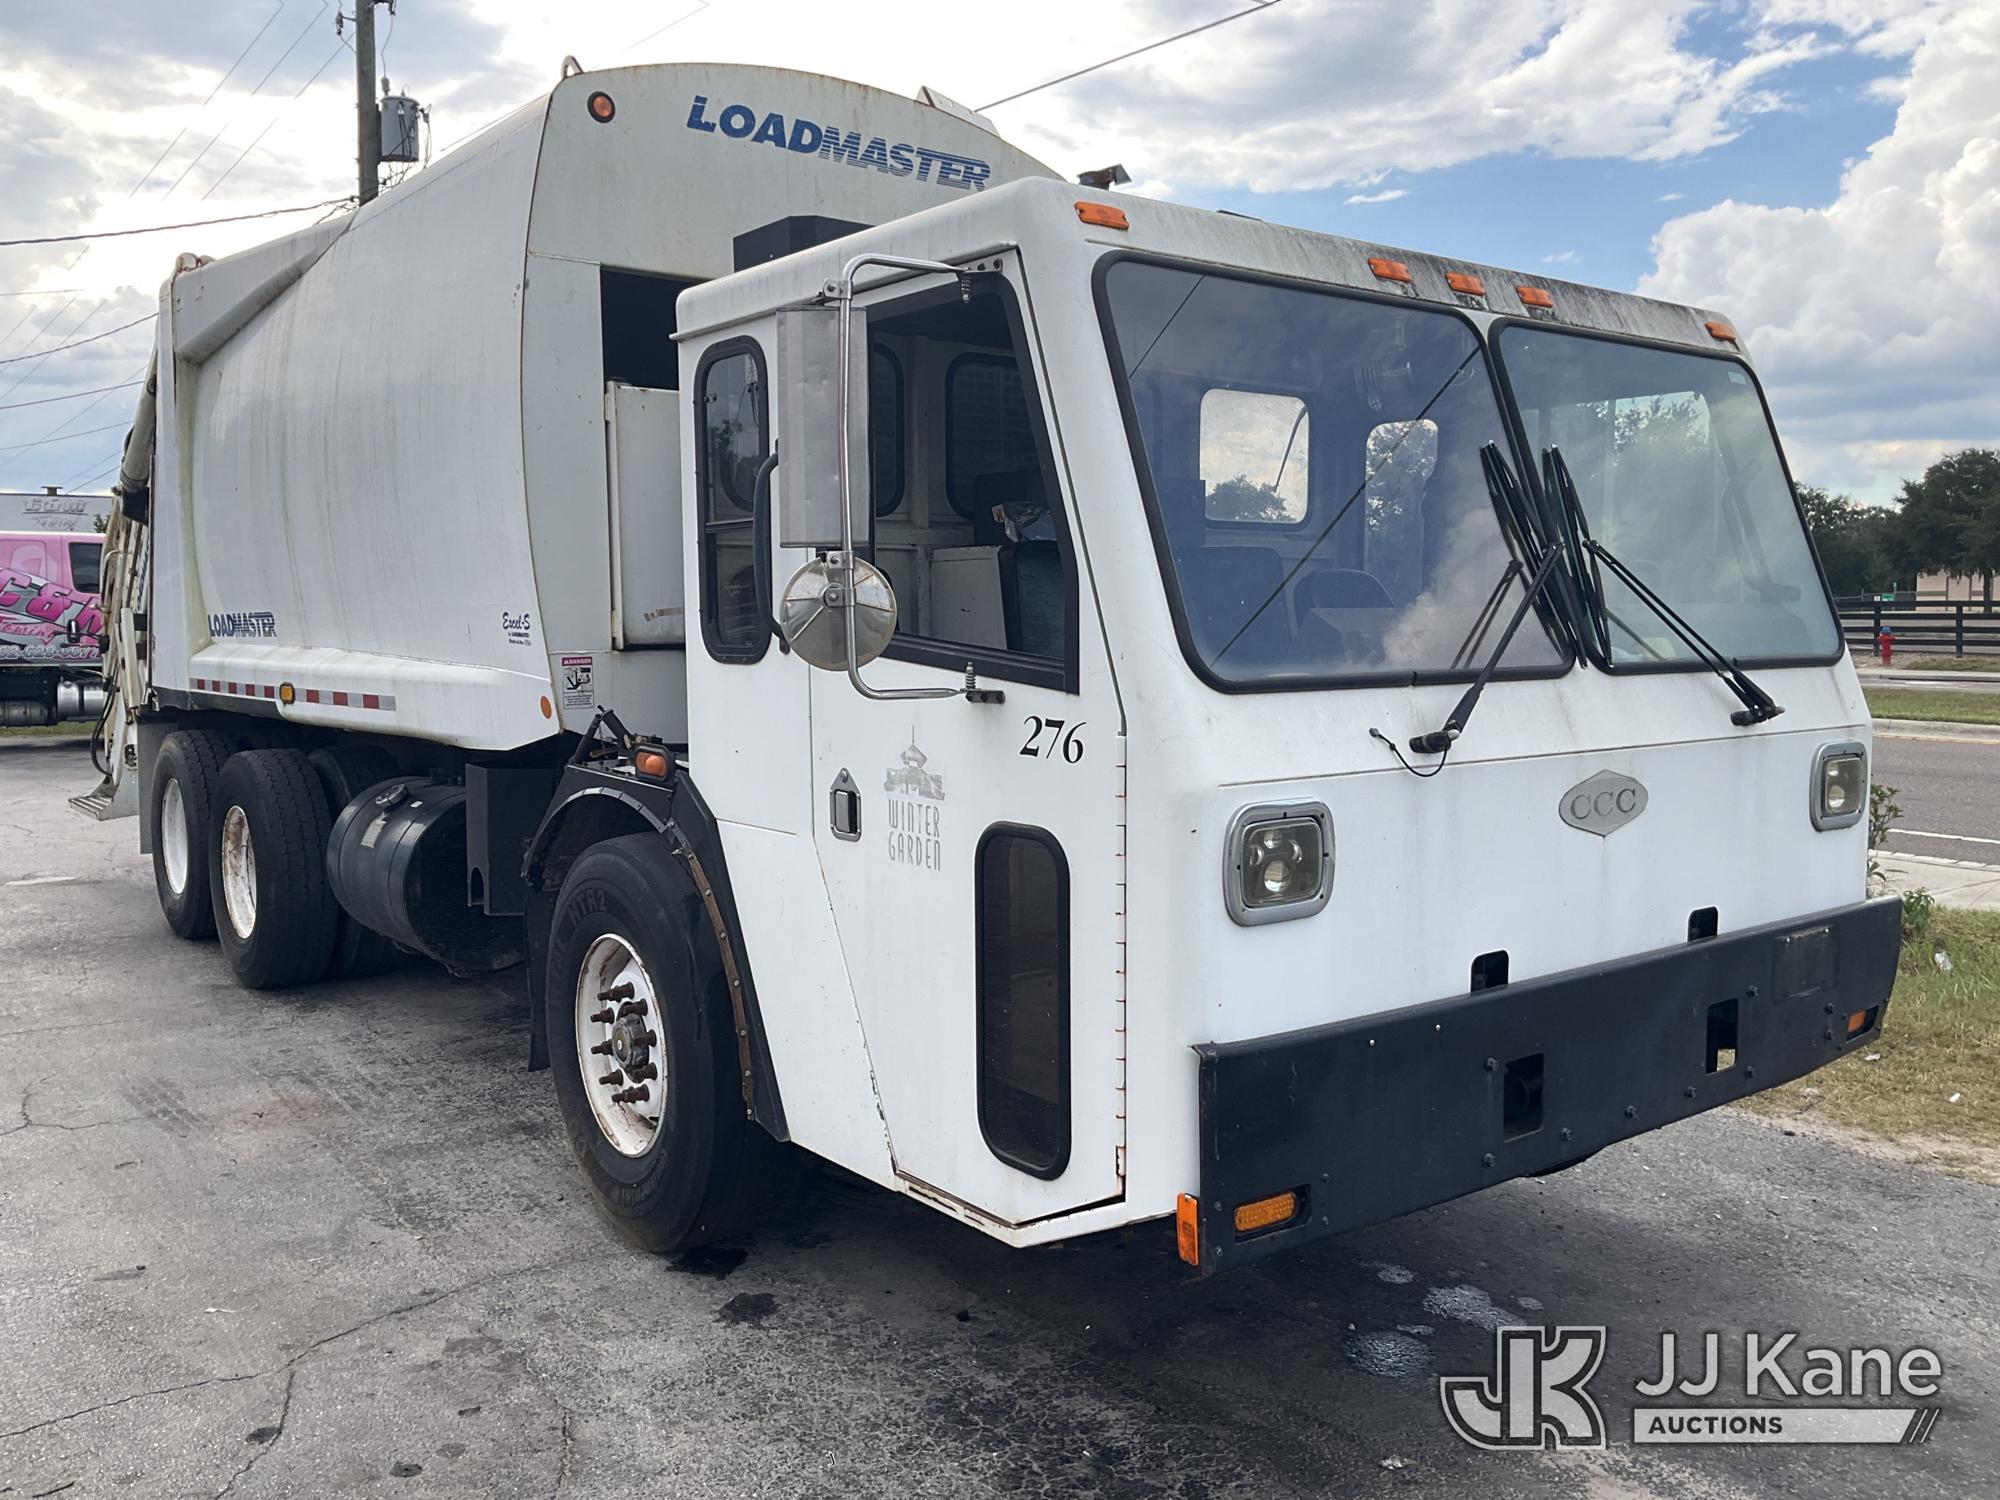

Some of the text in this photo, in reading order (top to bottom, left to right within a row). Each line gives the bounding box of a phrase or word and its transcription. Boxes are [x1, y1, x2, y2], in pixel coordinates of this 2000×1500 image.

[686, 95, 991, 192] LOADMASTER
[208, 611, 277, 637] LOADMASTER
[1019, 715, 1087, 763] 276
[888, 799, 940, 838] WINTER
[1570, 788, 1636, 820] CCC
[888, 832, 941, 871] GARDEN
